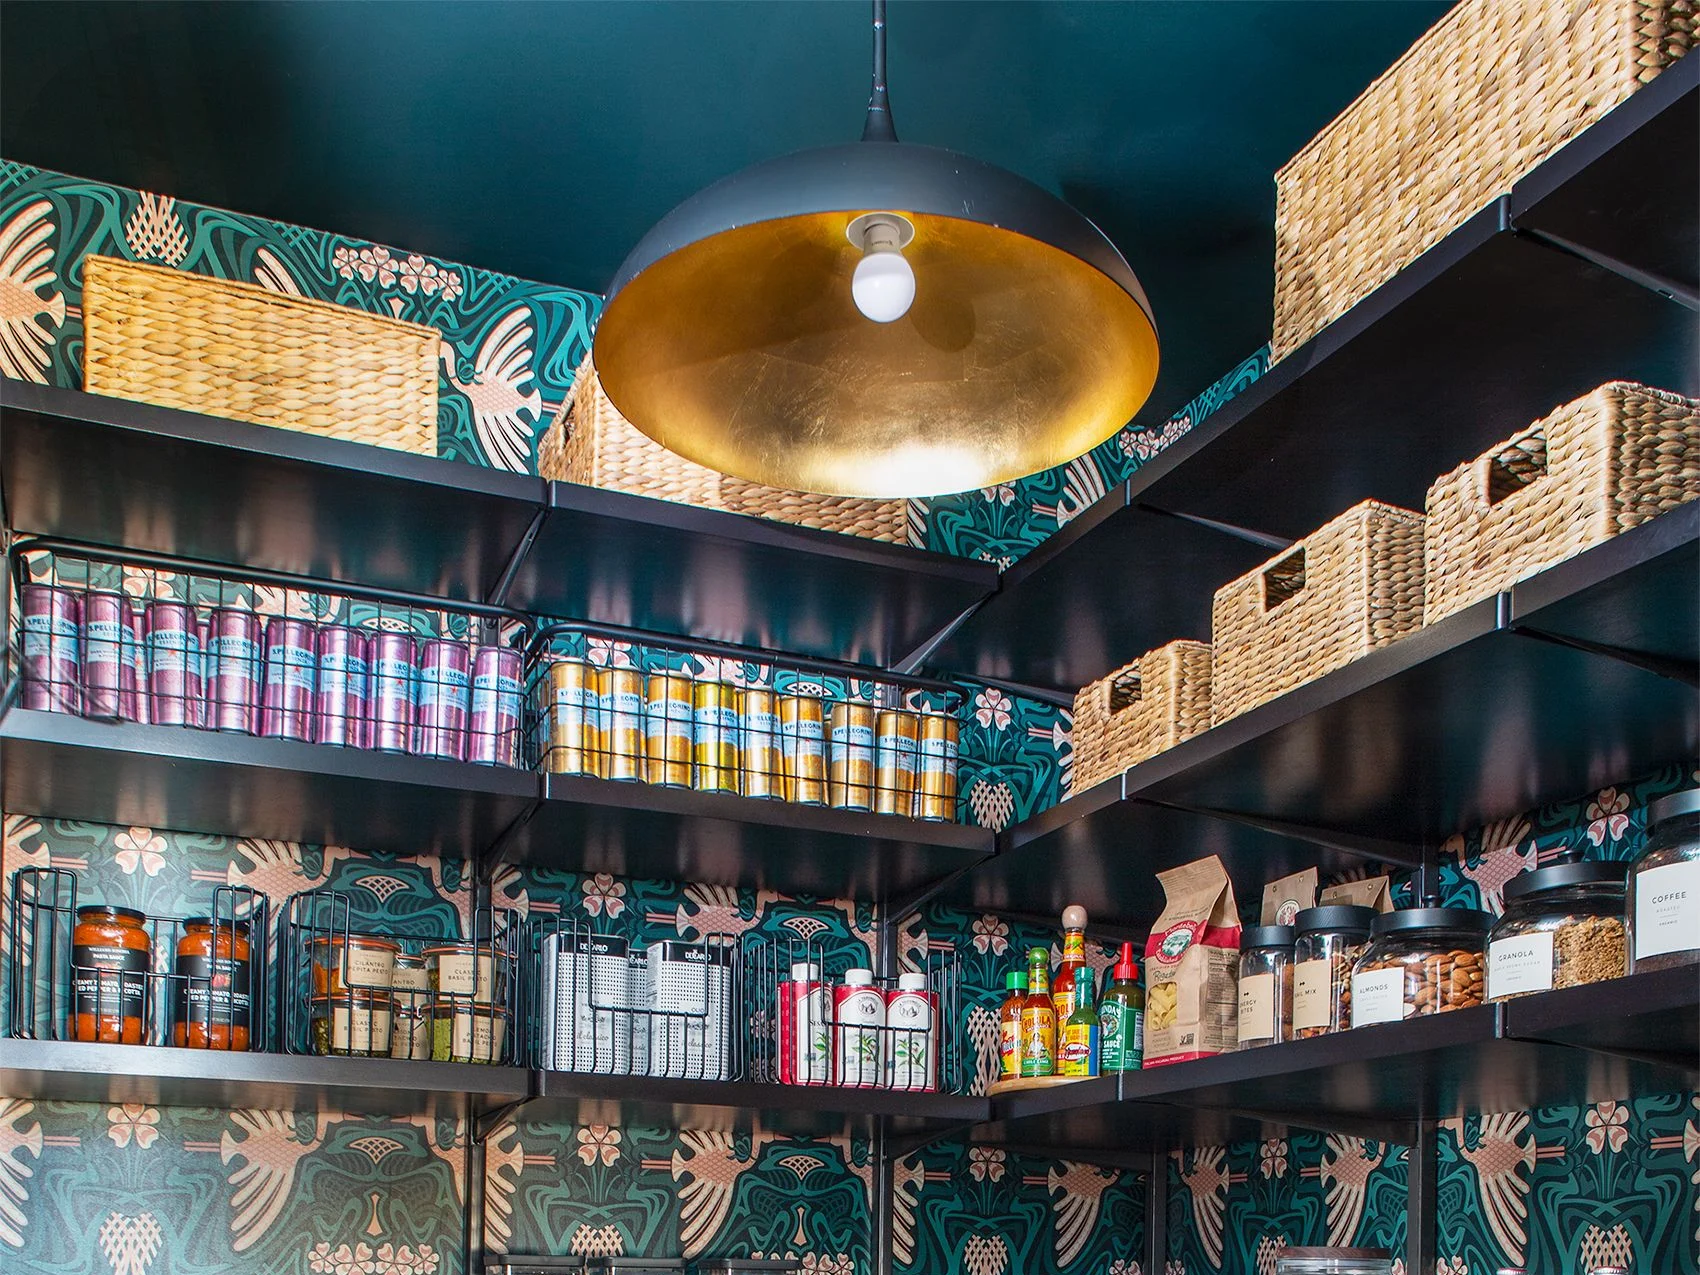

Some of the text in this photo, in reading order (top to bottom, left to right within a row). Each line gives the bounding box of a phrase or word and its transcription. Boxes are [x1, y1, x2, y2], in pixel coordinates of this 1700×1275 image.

[1651, 891, 1687, 904] COFFEE
[1498, 950, 1534, 962] GRANOLA
[1359, 984, 1388, 994] ALMONDS
